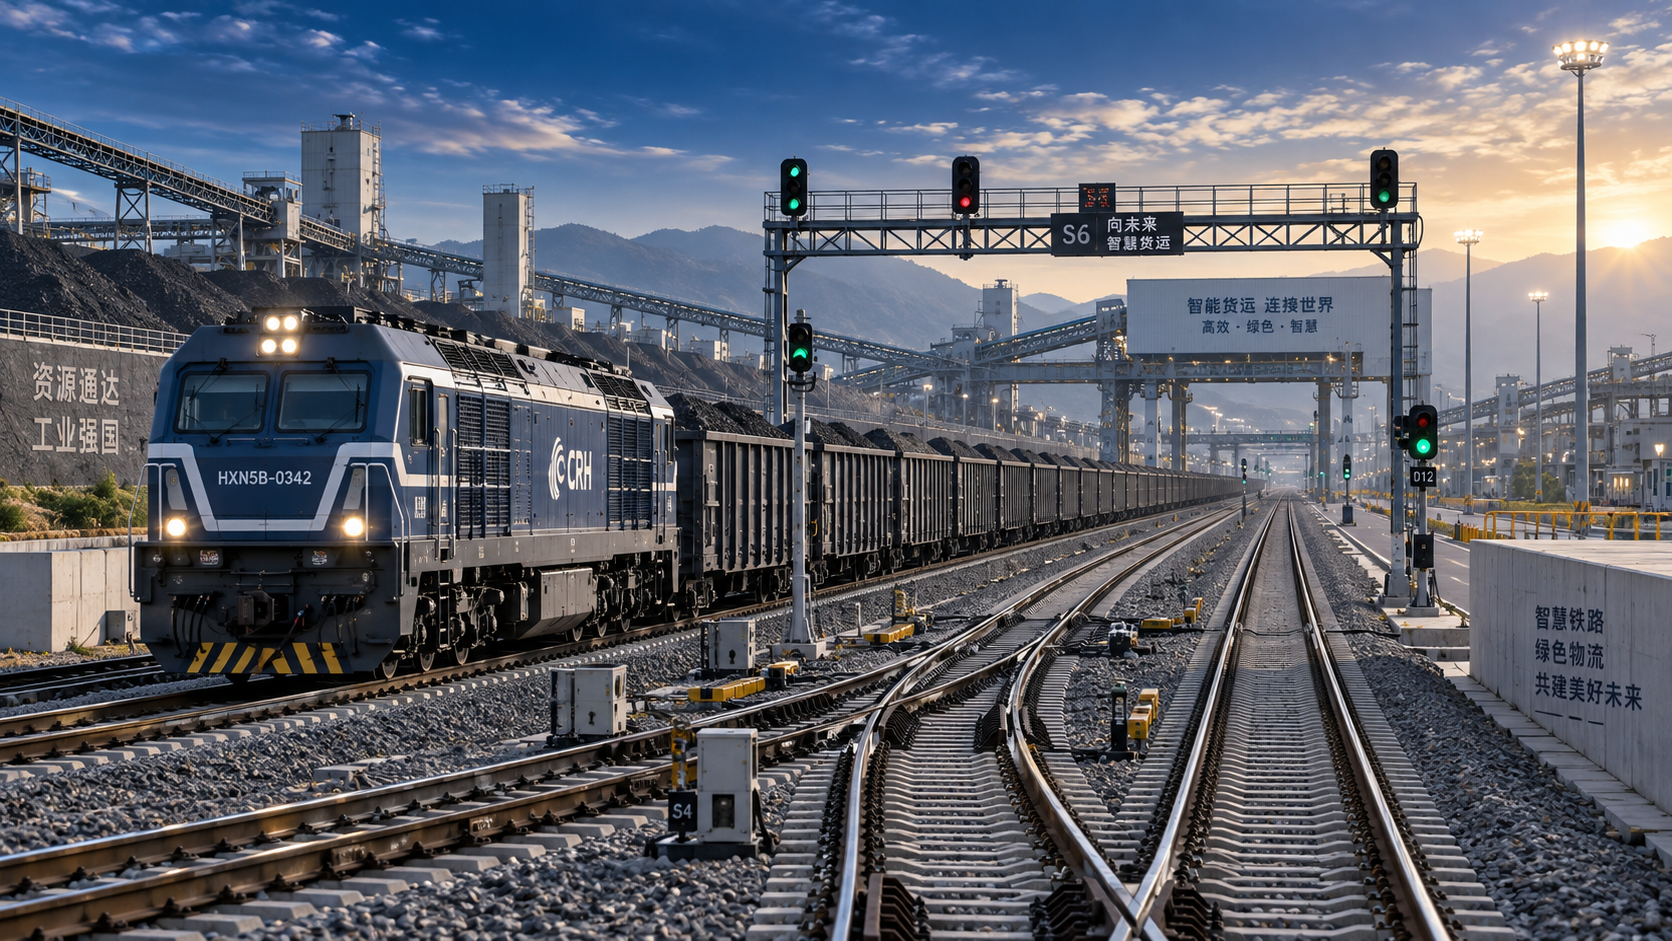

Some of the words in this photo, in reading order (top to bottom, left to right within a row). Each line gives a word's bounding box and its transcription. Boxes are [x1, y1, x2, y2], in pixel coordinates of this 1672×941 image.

[1062, 224, 1091, 244] S6
[1107, 216, 1158, 232] 向未来
[1107, 235, 1171, 251] 智慧货运
[1187, 297, 1256, 315] 智能货运
[1264, 296, 1334, 314] 连接世界
[32, 361, 120, 406] 资源通达
[32, 416, 119, 455] 工业强国
[218, 470, 312, 485] HXN5B-0342
[567, 449, 592, 491] CRH
[1535, 605, 1604, 634] 智慧铁路
[1535, 638, 1604, 670] 绿色物流
[1535, 671, 1643, 711] 共建美好未来
[672, 803, 693, 819] S4
